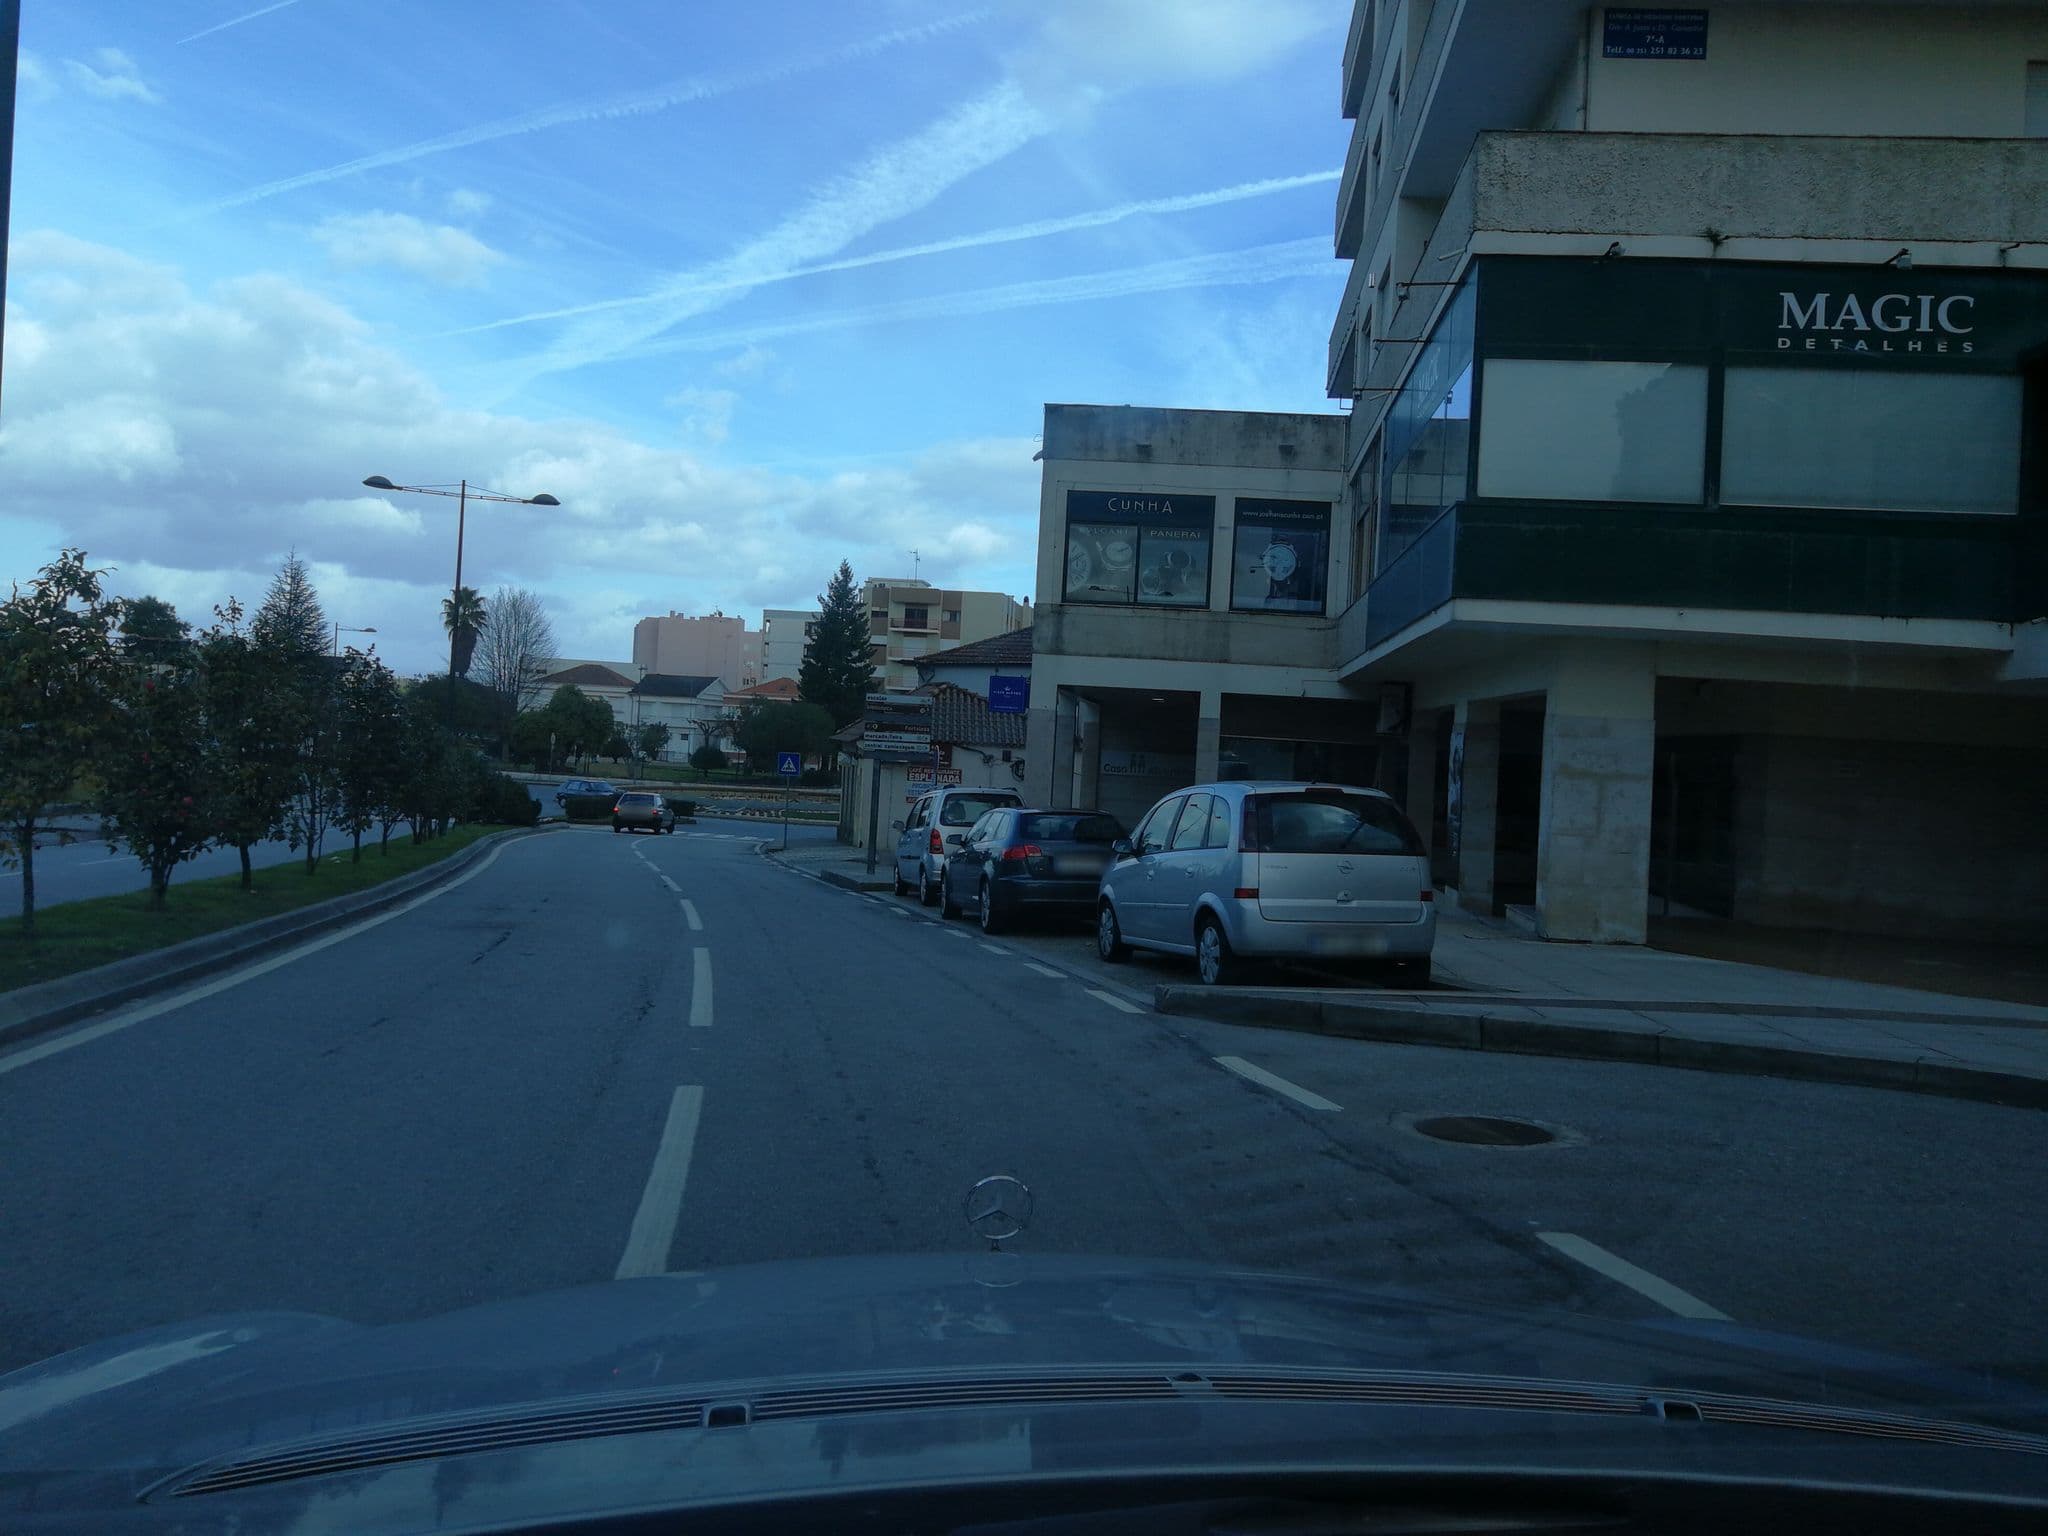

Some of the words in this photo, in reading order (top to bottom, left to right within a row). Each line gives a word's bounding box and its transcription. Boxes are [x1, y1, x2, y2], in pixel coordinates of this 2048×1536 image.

[1650, 46, 1665, 55] 251
[1680, 47, 1691, 55] 36
[1777, 291, 1976, 334] MAGIC
[1777, 337, 1975, 353] DETALHES
[1107, 497, 1174, 515] CUNHA
[1149, 529, 1201, 539] PANERAI
[908, 772, 961, 784] ESPLNADA
